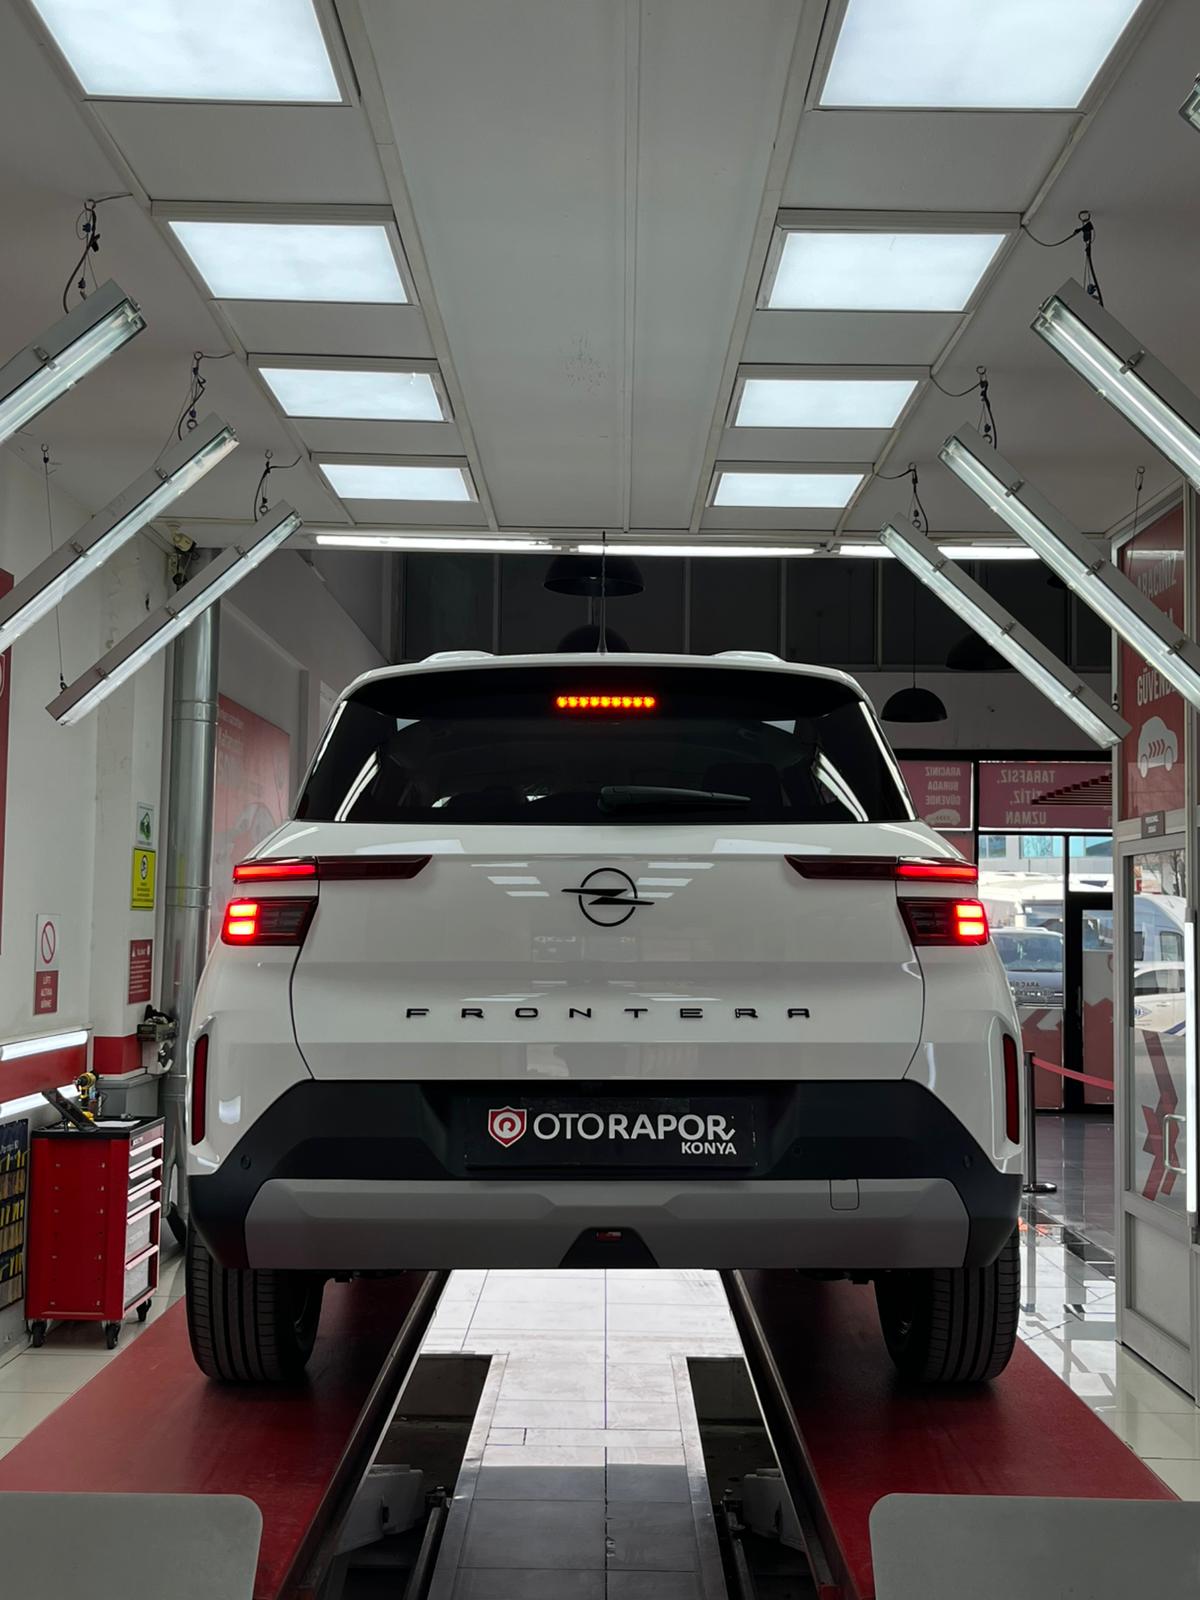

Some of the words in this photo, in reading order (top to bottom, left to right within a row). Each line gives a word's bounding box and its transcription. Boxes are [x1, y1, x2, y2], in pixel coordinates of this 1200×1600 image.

[405, 1007, 811, 1020] FRONTERA
[533, 1113, 736, 1141] OTORAPOR
[681, 1142, 737, 1155] KONYA
